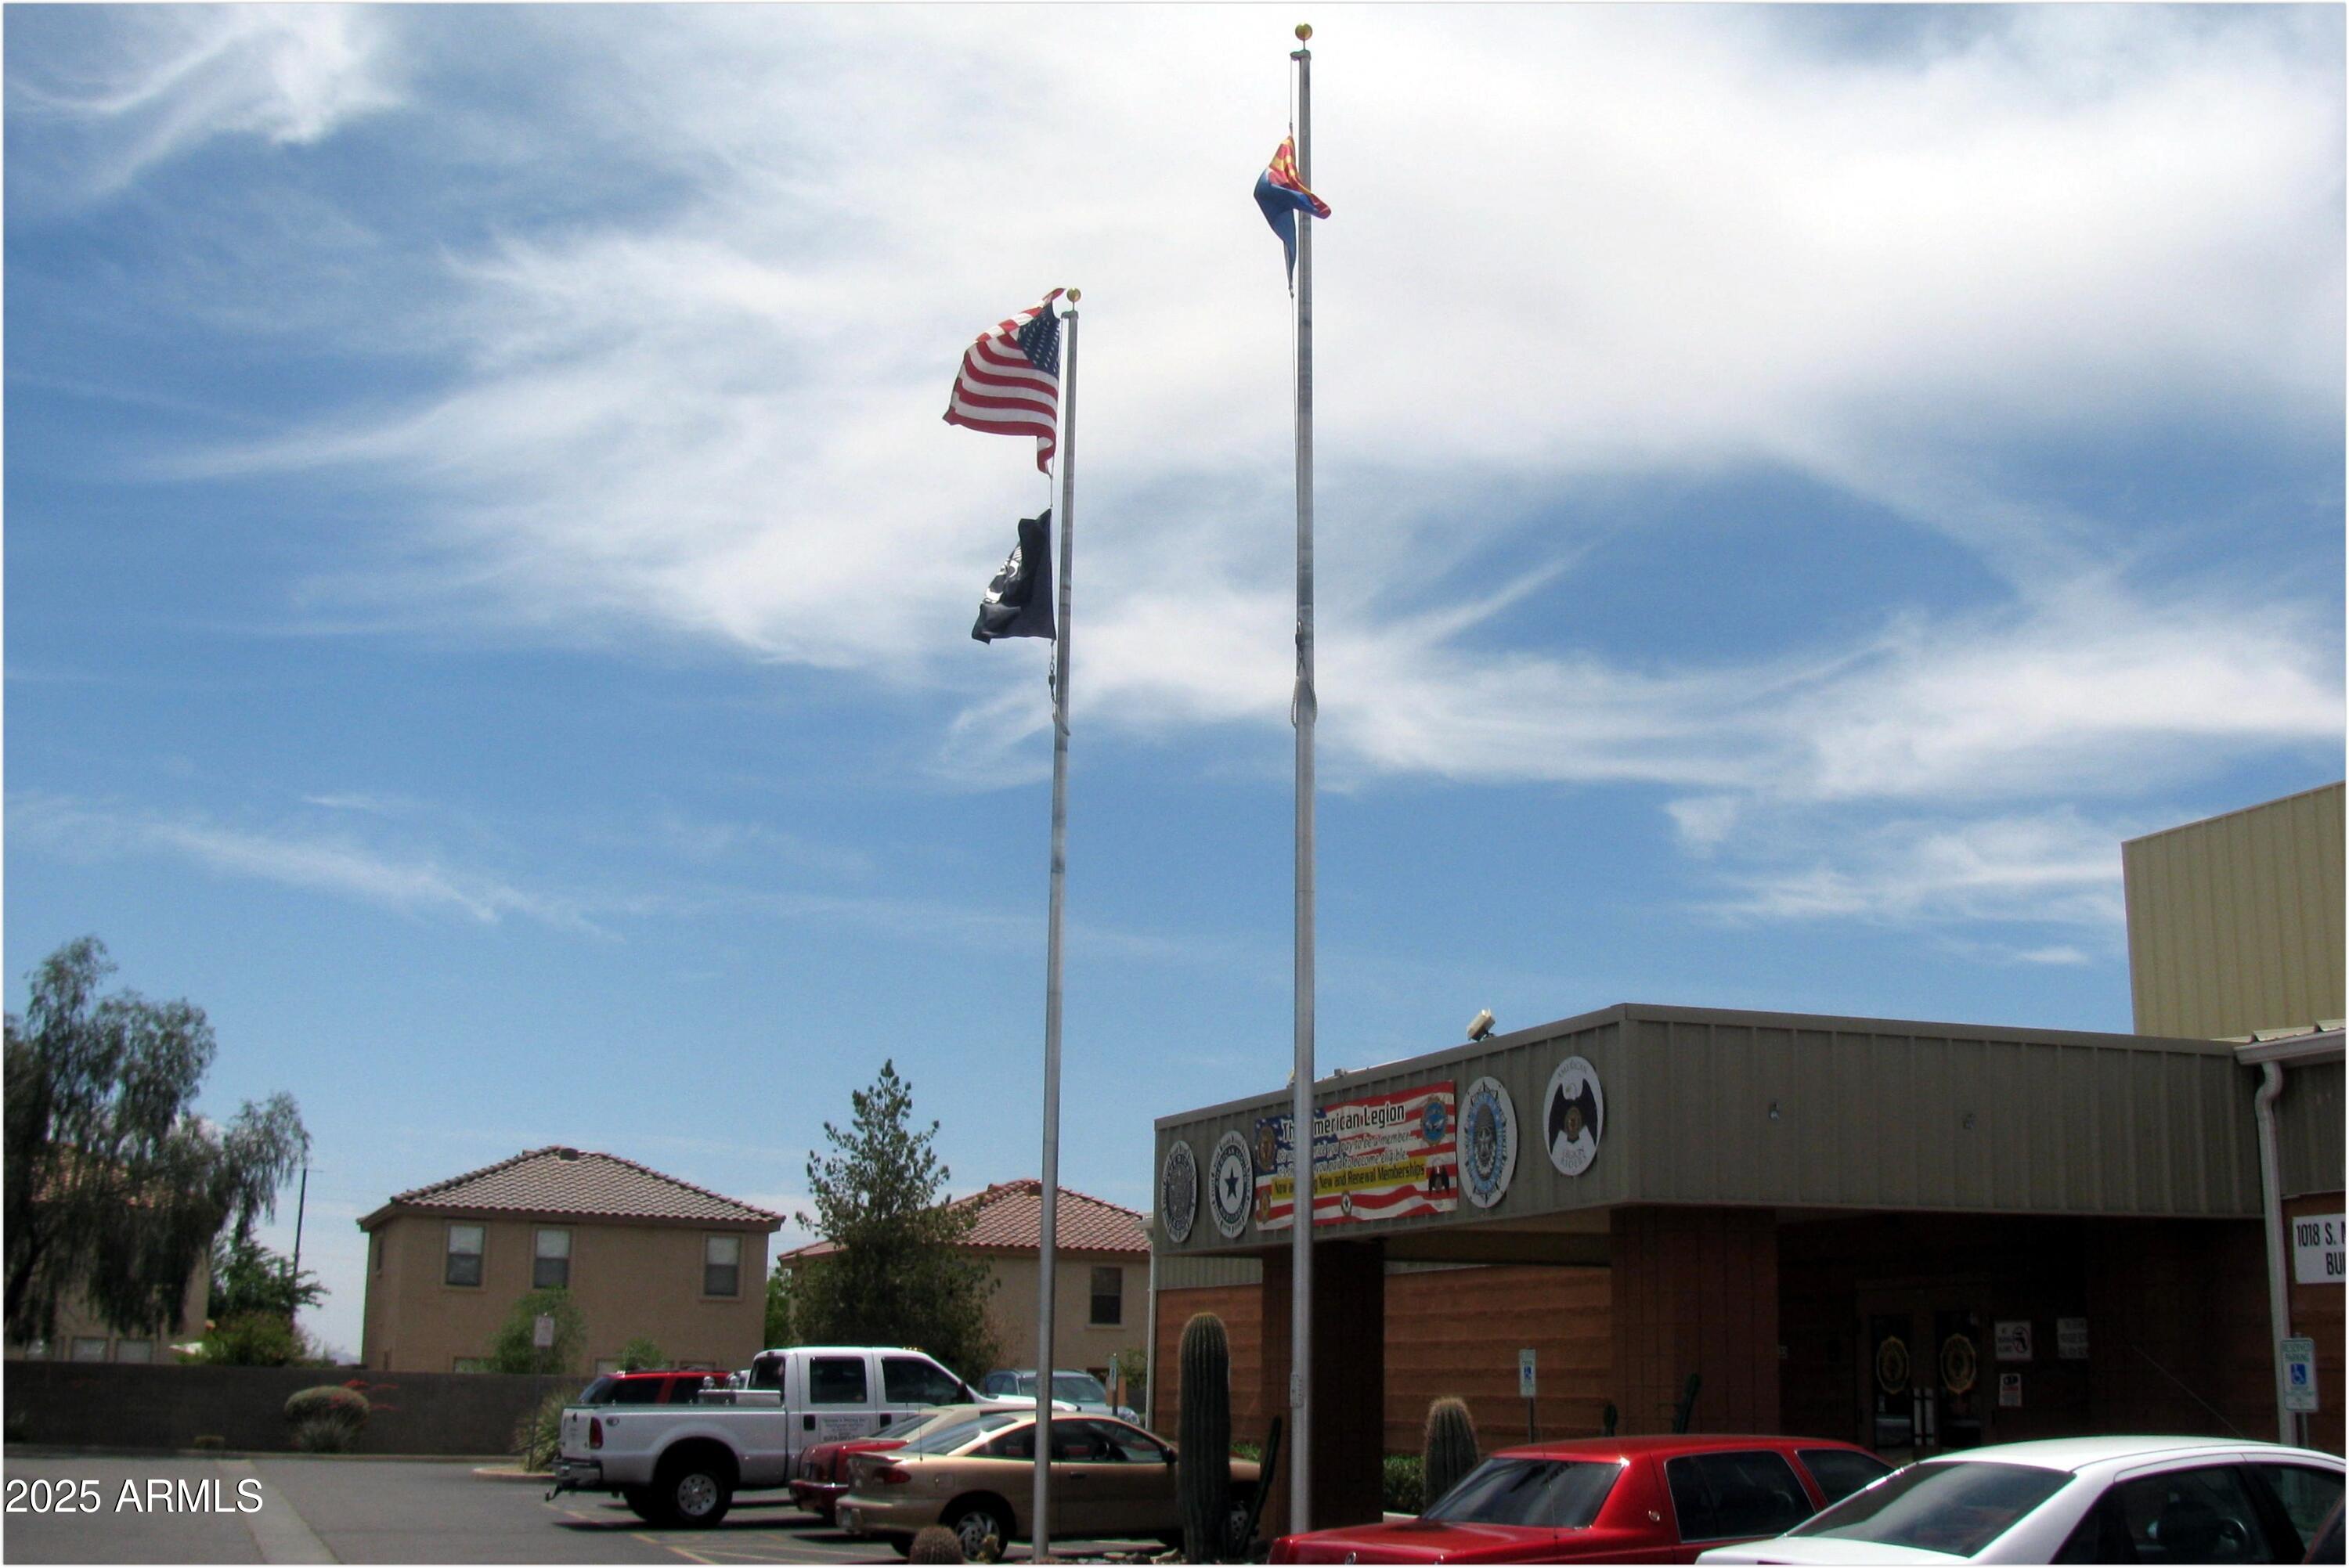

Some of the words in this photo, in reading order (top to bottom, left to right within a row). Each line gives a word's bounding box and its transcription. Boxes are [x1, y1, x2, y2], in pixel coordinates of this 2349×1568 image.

[1315, 1112, 1360, 1135] merican
[1364, 1104, 1405, 1129] Legion
[1319, 1174, 1333, 1188] New
[1334, 1172, 1346, 1187] and
[1348, 1167, 1376, 1185] Renewal
[1377, 1160, 1424, 1181] Memberships
[2297, 1223, 2320, 1247] 1018
[2325, 1222, 2336, 1245] S.
